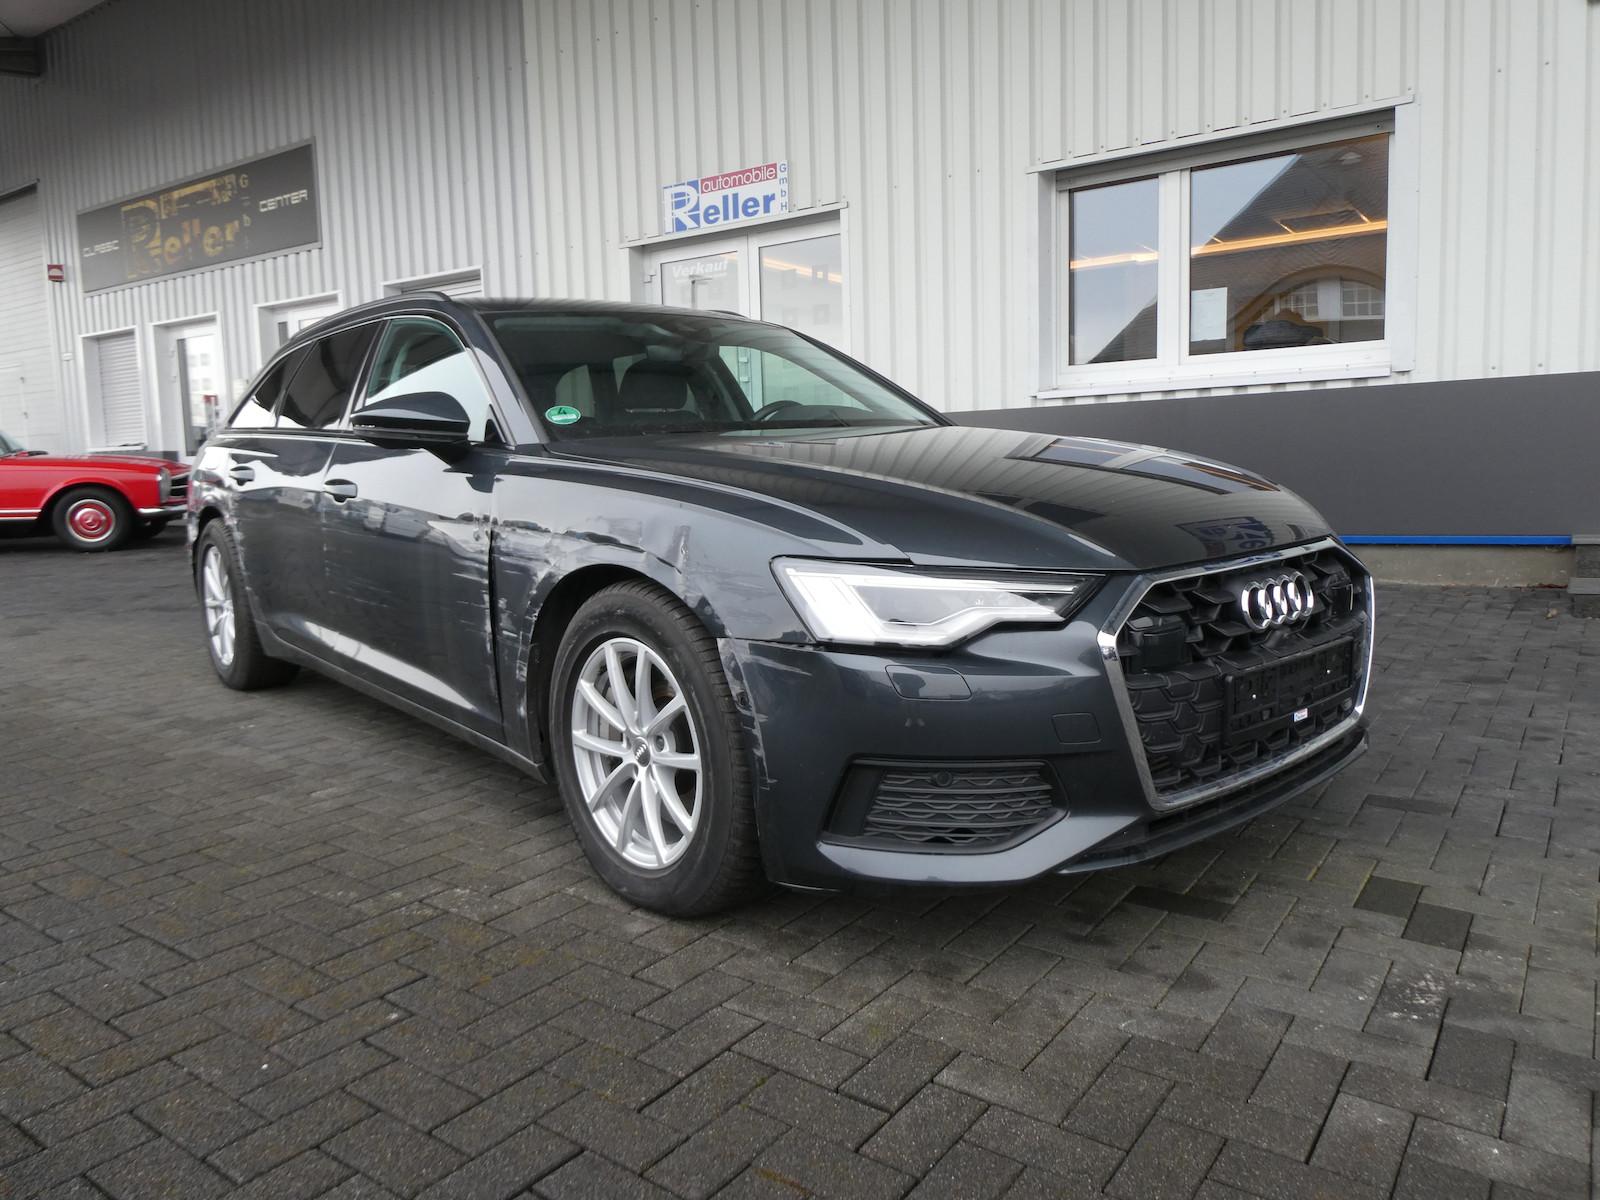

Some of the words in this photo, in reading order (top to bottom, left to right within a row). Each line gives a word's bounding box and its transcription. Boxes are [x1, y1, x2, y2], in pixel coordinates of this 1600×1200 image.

[702, 166, 776, 193] automobile
[779, 163, 788, 212] GmbH
[259, 189, 308, 212] CENTER
[662, 182, 776, 234] Reller
[672, 258, 728, 278] Verkauf
